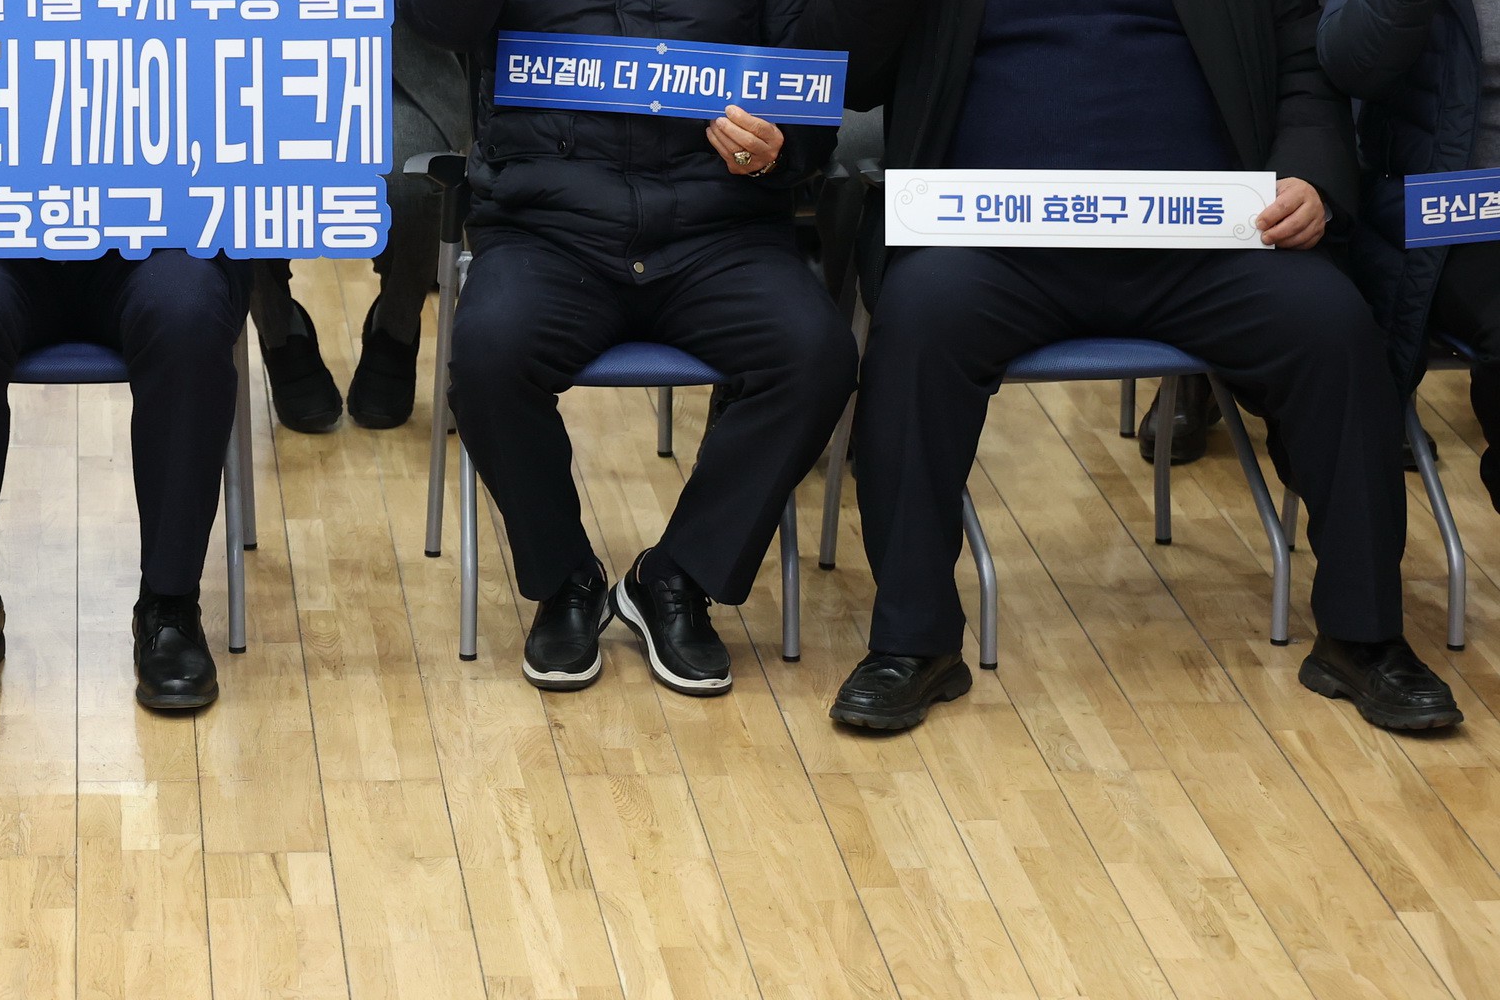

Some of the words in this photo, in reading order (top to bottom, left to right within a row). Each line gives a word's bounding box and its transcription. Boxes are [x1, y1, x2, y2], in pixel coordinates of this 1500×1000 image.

[509, 55, 605, 90] 당신곁에,
[614, 61, 638, 89] 더
[648, 63, 731, 99] 가까이,
[742, 71, 768, 100] 더
[777, 74, 831, 102] 크게
[35, 38, 200, 176] 가까이,
[215, 38, 263, 164] 더
[279, 37, 382, 163] 크게
[189, 186, 381, 248] 기배동
[938, 195, 965, 221] 그
[976, 195, 1031, 222] 안에
[1042, 195, 1128, 223] 효행구
[1140, 195, 1225, 226] 기배동
